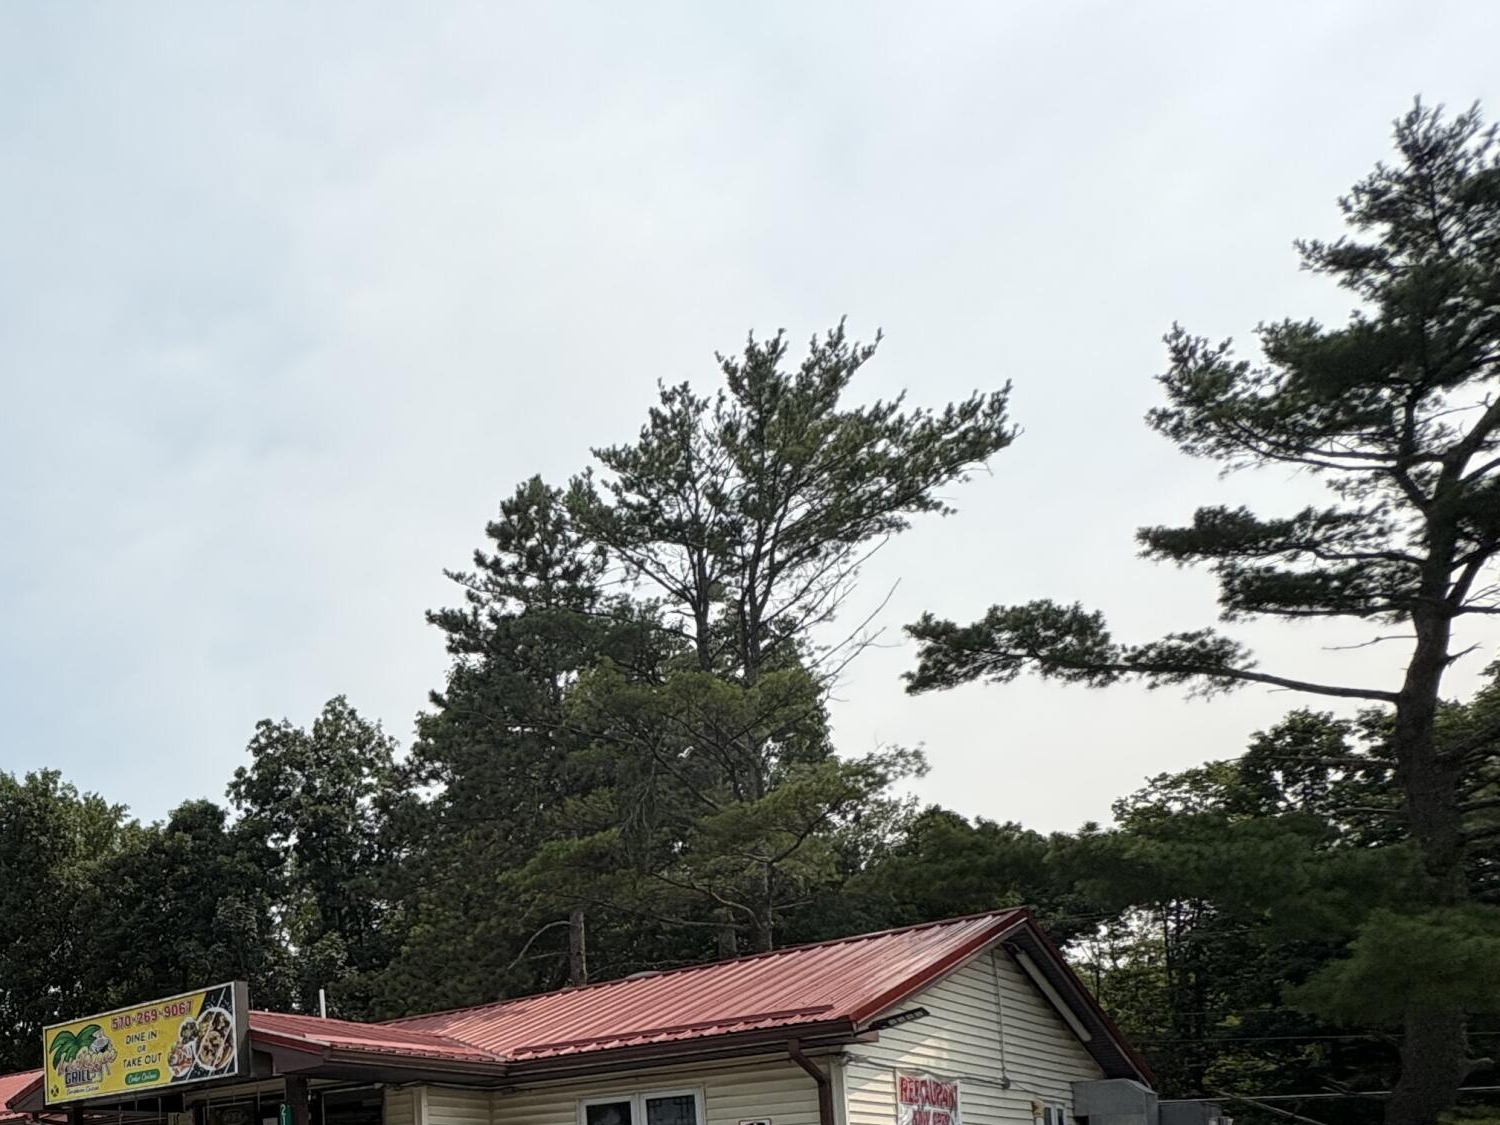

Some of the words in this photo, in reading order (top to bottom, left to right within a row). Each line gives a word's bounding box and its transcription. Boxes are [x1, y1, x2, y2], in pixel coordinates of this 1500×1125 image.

[111, 1000, 193, 1031] 570-269-9067
[126, 1032, 146, 1044] DINE
[148, 1030, 157, 1041] IN
[137, 1045, 146, 1053] OR
[123, 1056, 143, 1068] TAKE
[144, 1053, 162, 1064] OUT
[65, 1070, 91, 1085] GRILL
